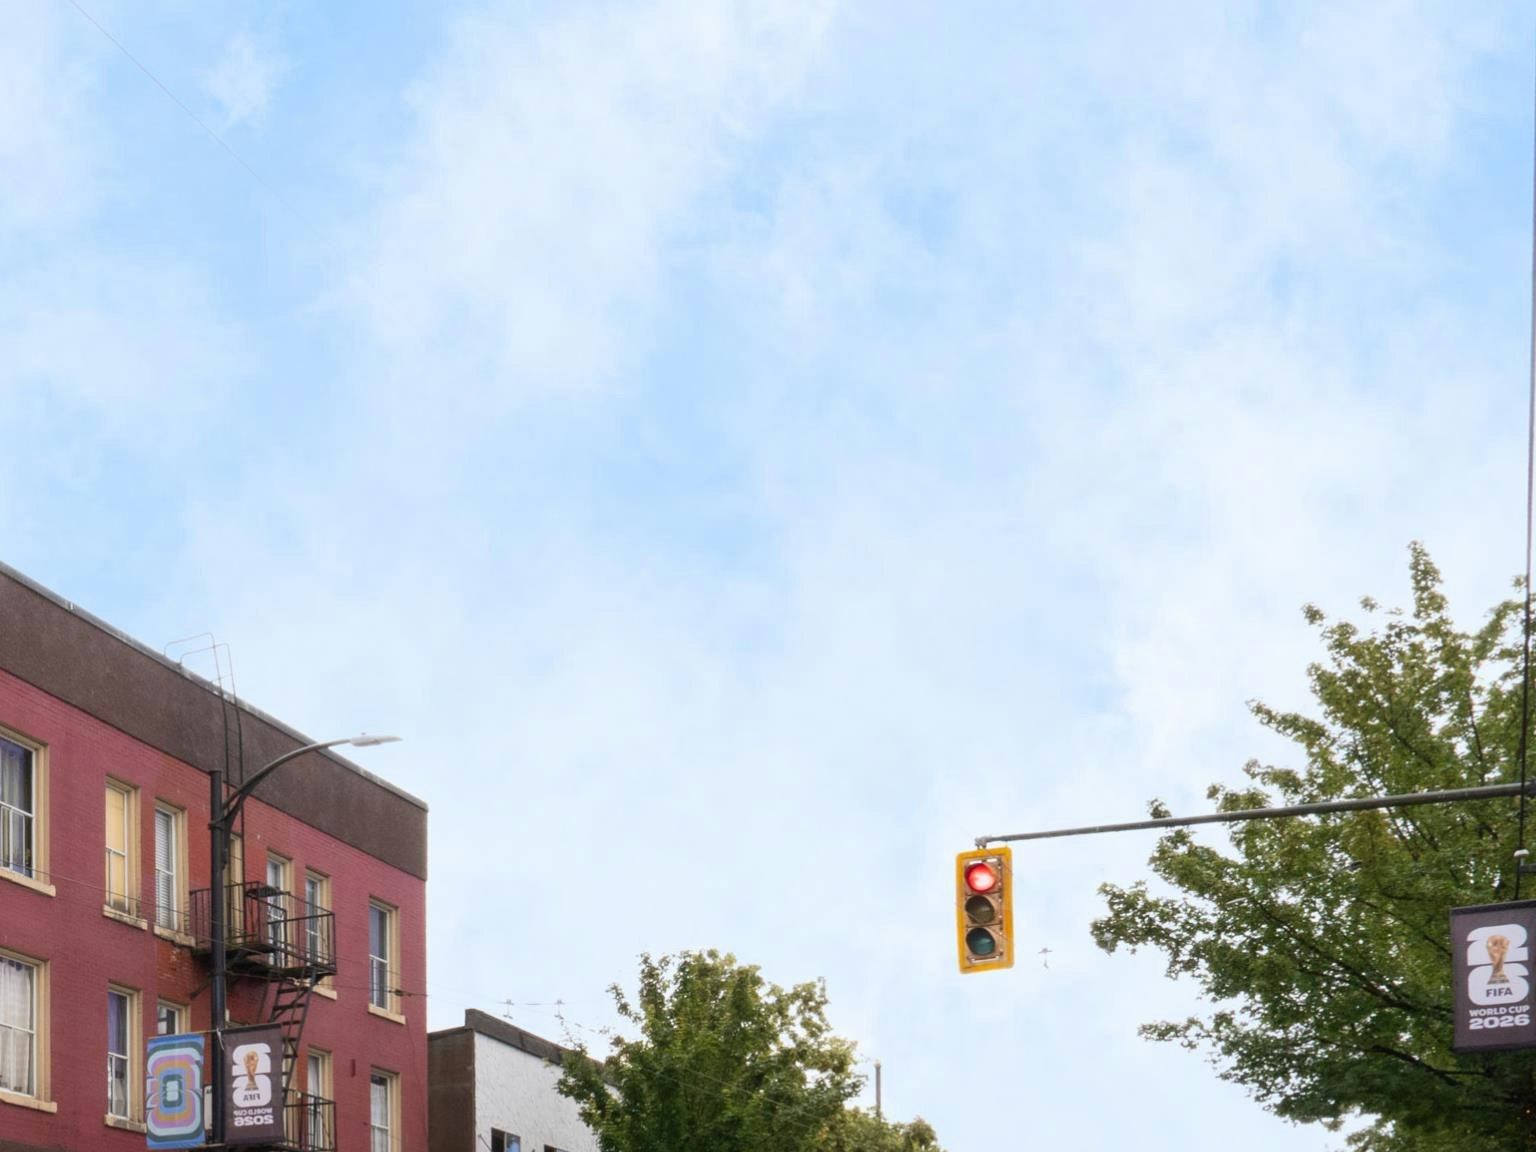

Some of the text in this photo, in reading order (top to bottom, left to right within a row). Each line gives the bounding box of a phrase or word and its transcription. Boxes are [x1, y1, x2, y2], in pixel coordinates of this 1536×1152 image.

[1486, 987, 1513, 998] FIFA
[1469, 1005, 1530, 1017] WORLD CUP
[1469, 1013, 1531, 1030] 2026
